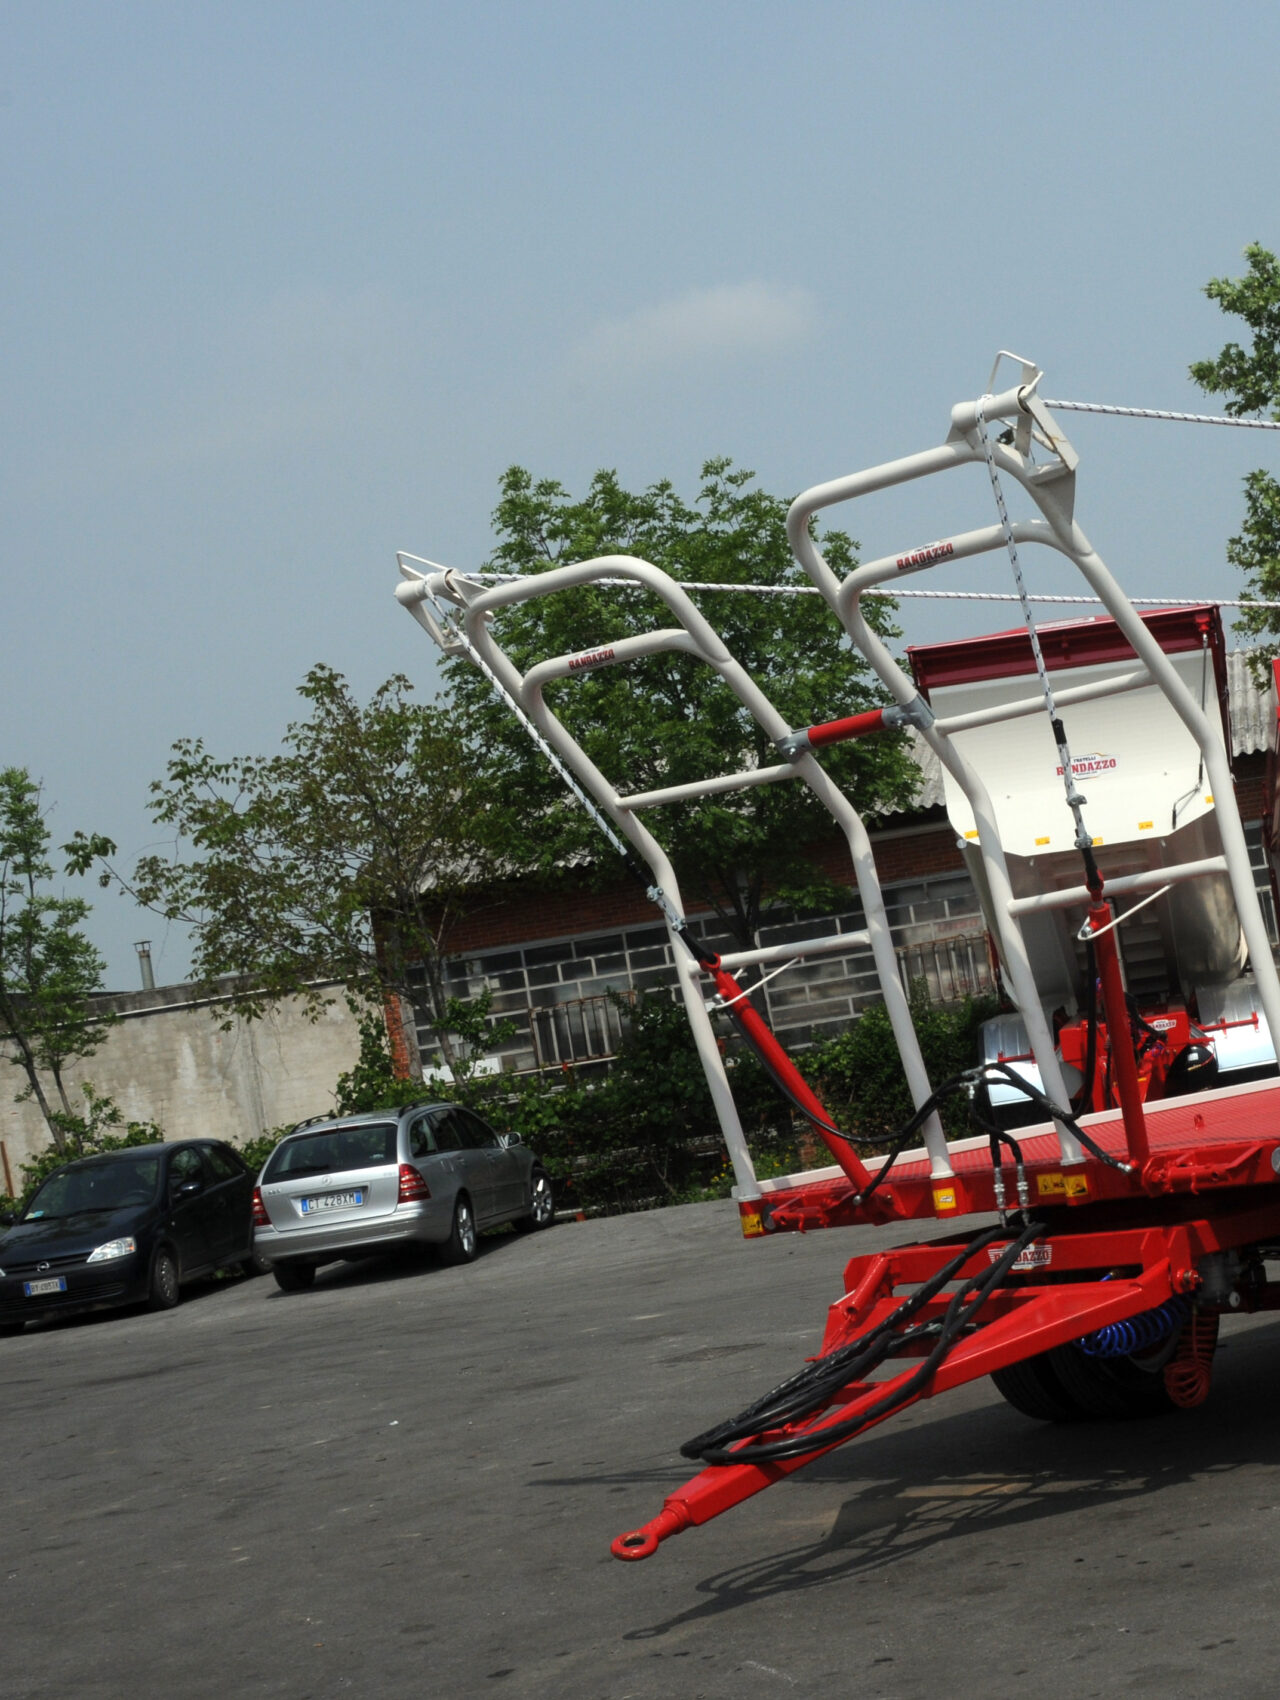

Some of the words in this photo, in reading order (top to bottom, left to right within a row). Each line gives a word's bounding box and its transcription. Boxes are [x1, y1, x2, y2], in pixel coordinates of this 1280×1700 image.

[896, 542, 954, 570] RANDAZZO
[1056, 758, 1117, 776] RNDAZZO
[308, 1198, 320, 1210] CT
[324, 1192, 356, 1207] 428XM
